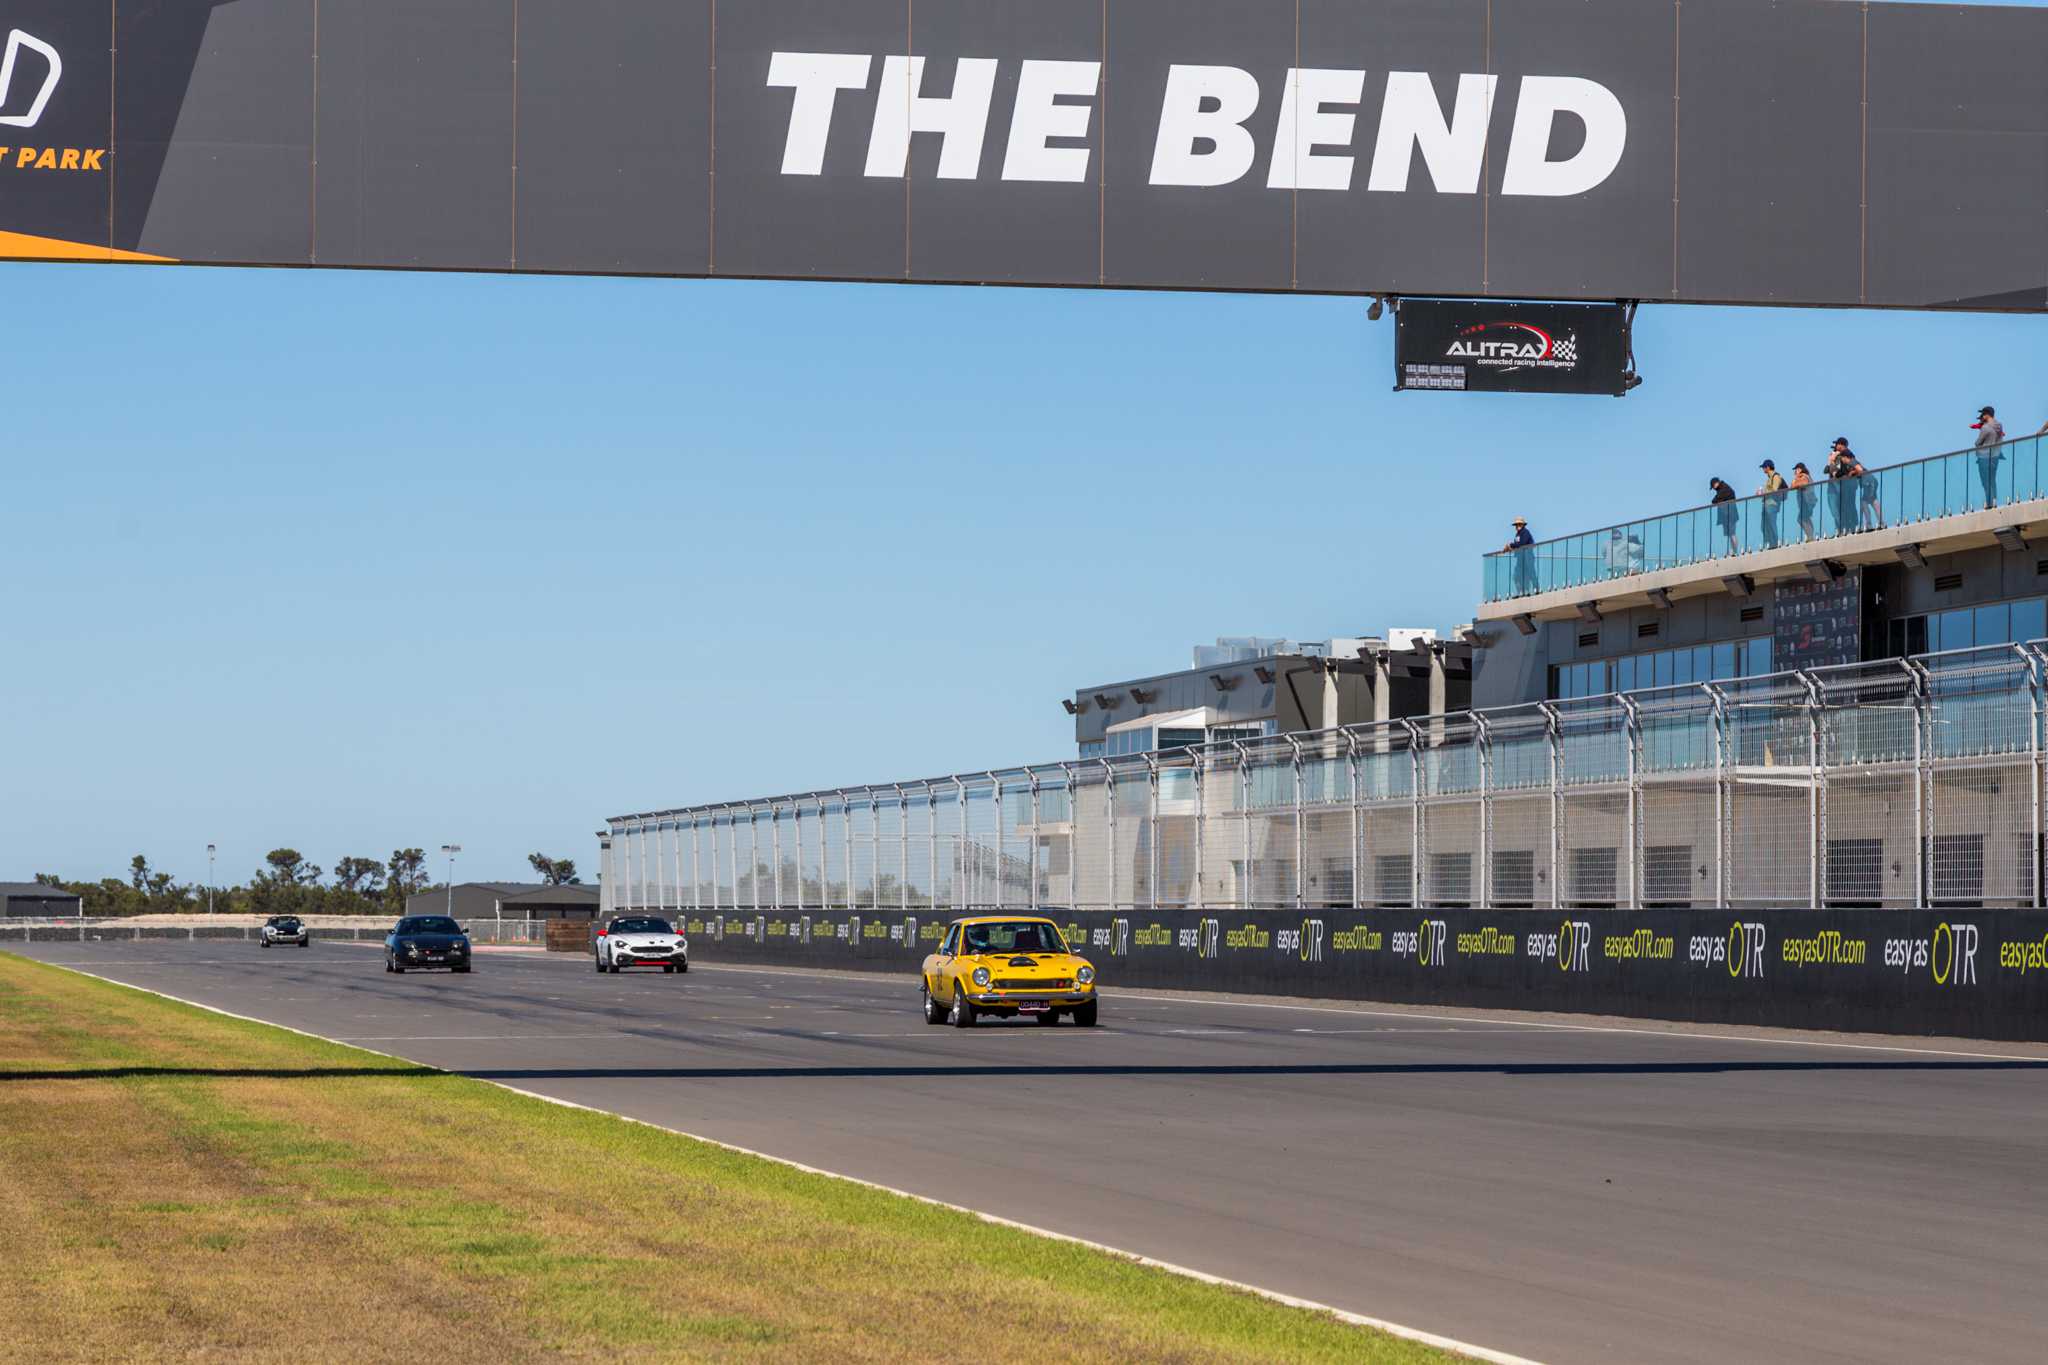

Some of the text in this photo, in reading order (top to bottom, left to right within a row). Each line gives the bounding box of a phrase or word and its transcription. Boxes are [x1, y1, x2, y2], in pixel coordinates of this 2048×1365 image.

[765, 51, 1628, 196] THE BEND
[16, 147, 106, 171] PARK
[1477, 358, 1513, 366] connected
[1514, 359, 1536, 367] racing
[1199, 917, 1219, 958] OTR
[1300, 918, 1324, 962] OTR
[1419, 919, 1446, 966] OTR
[1457, 927, 1515, 959] easyasOTR.com
[1559, 920, 1591, 972] OTR
[1604, 928, 1674, 964] easyasOTR.com
[1727, 920, 1766, 978] OTR
[1782, 930, 1866, 968] easyasOTR.com
[1932, 922, 1979, 985] OTR
